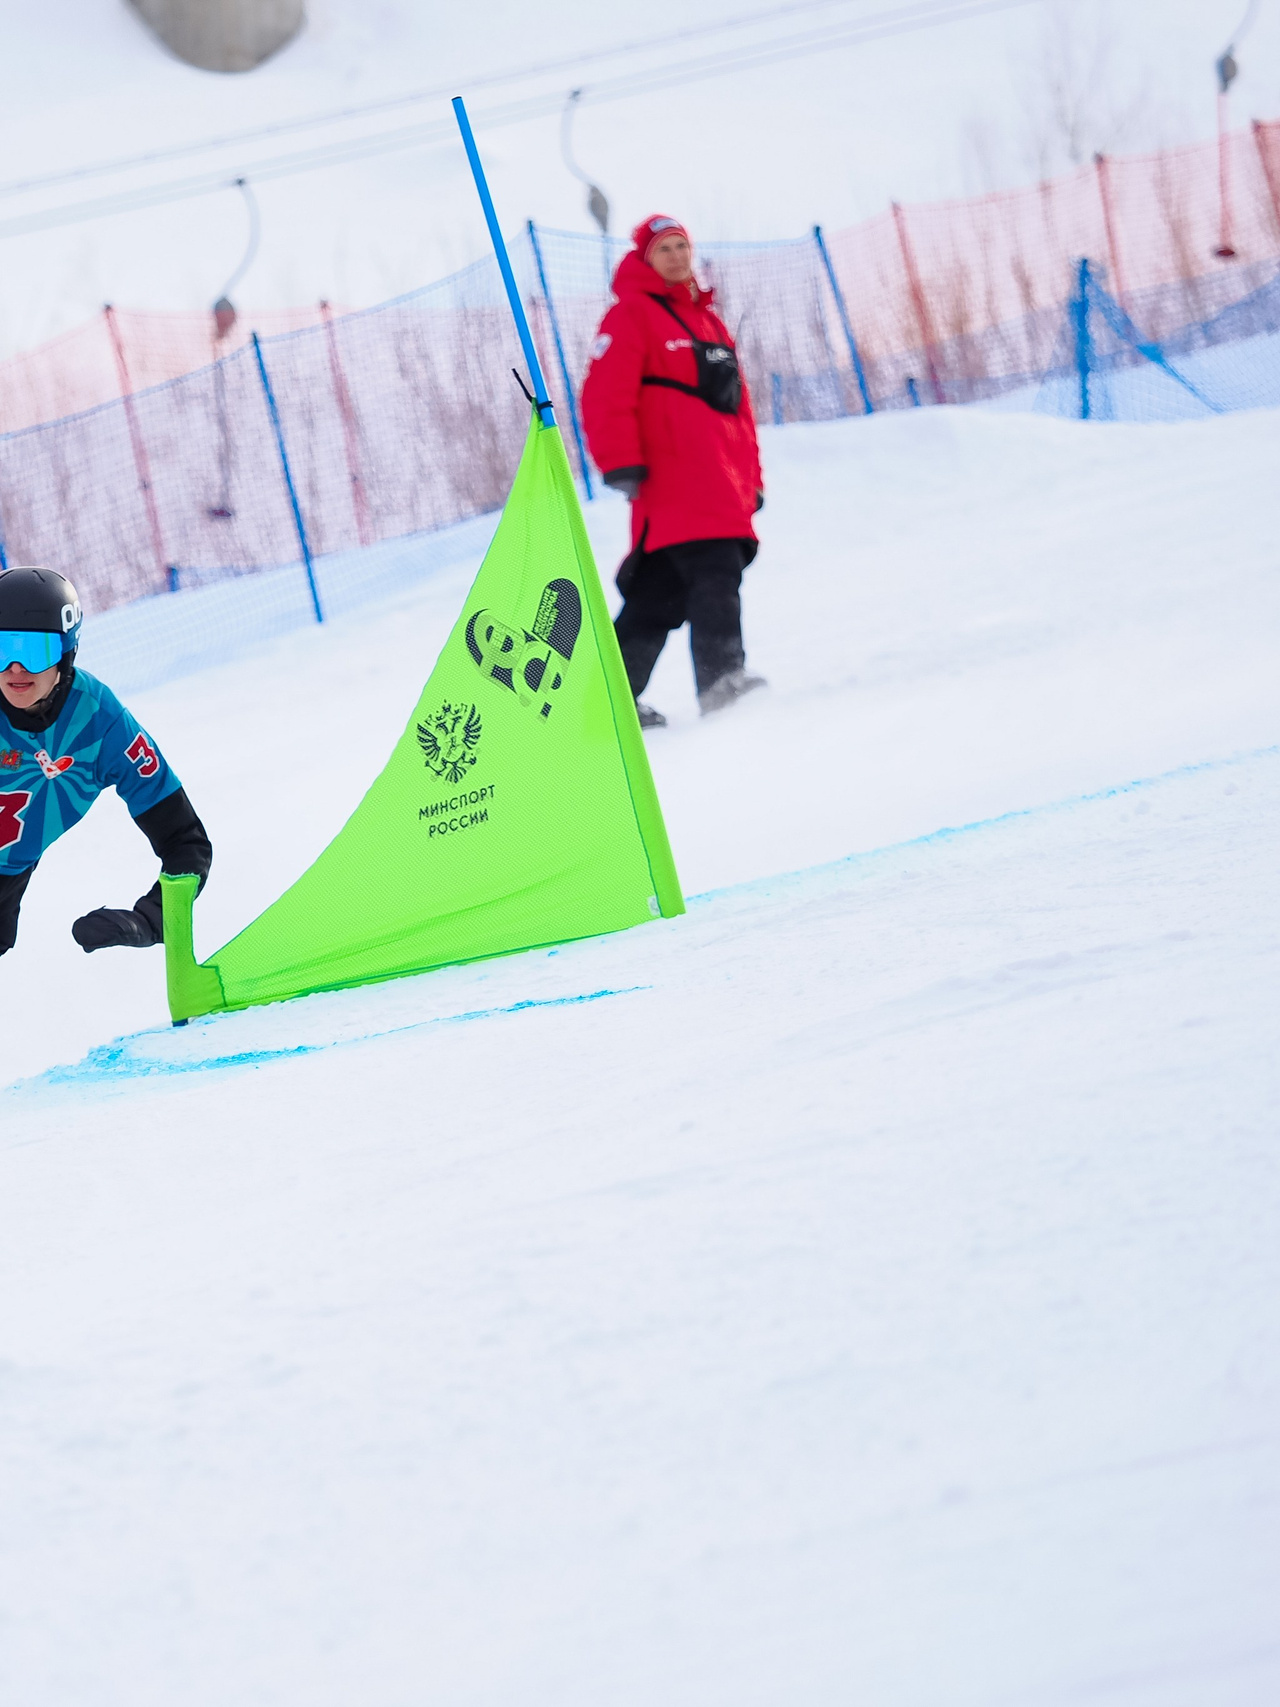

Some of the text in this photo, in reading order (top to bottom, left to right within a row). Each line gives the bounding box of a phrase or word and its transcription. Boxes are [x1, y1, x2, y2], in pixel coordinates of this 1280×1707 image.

[124, 731, 160, 778] 3
[418, 784, 495, 821] МИНСПОРТ
[428, 808, 489, 838] РОССИИ
